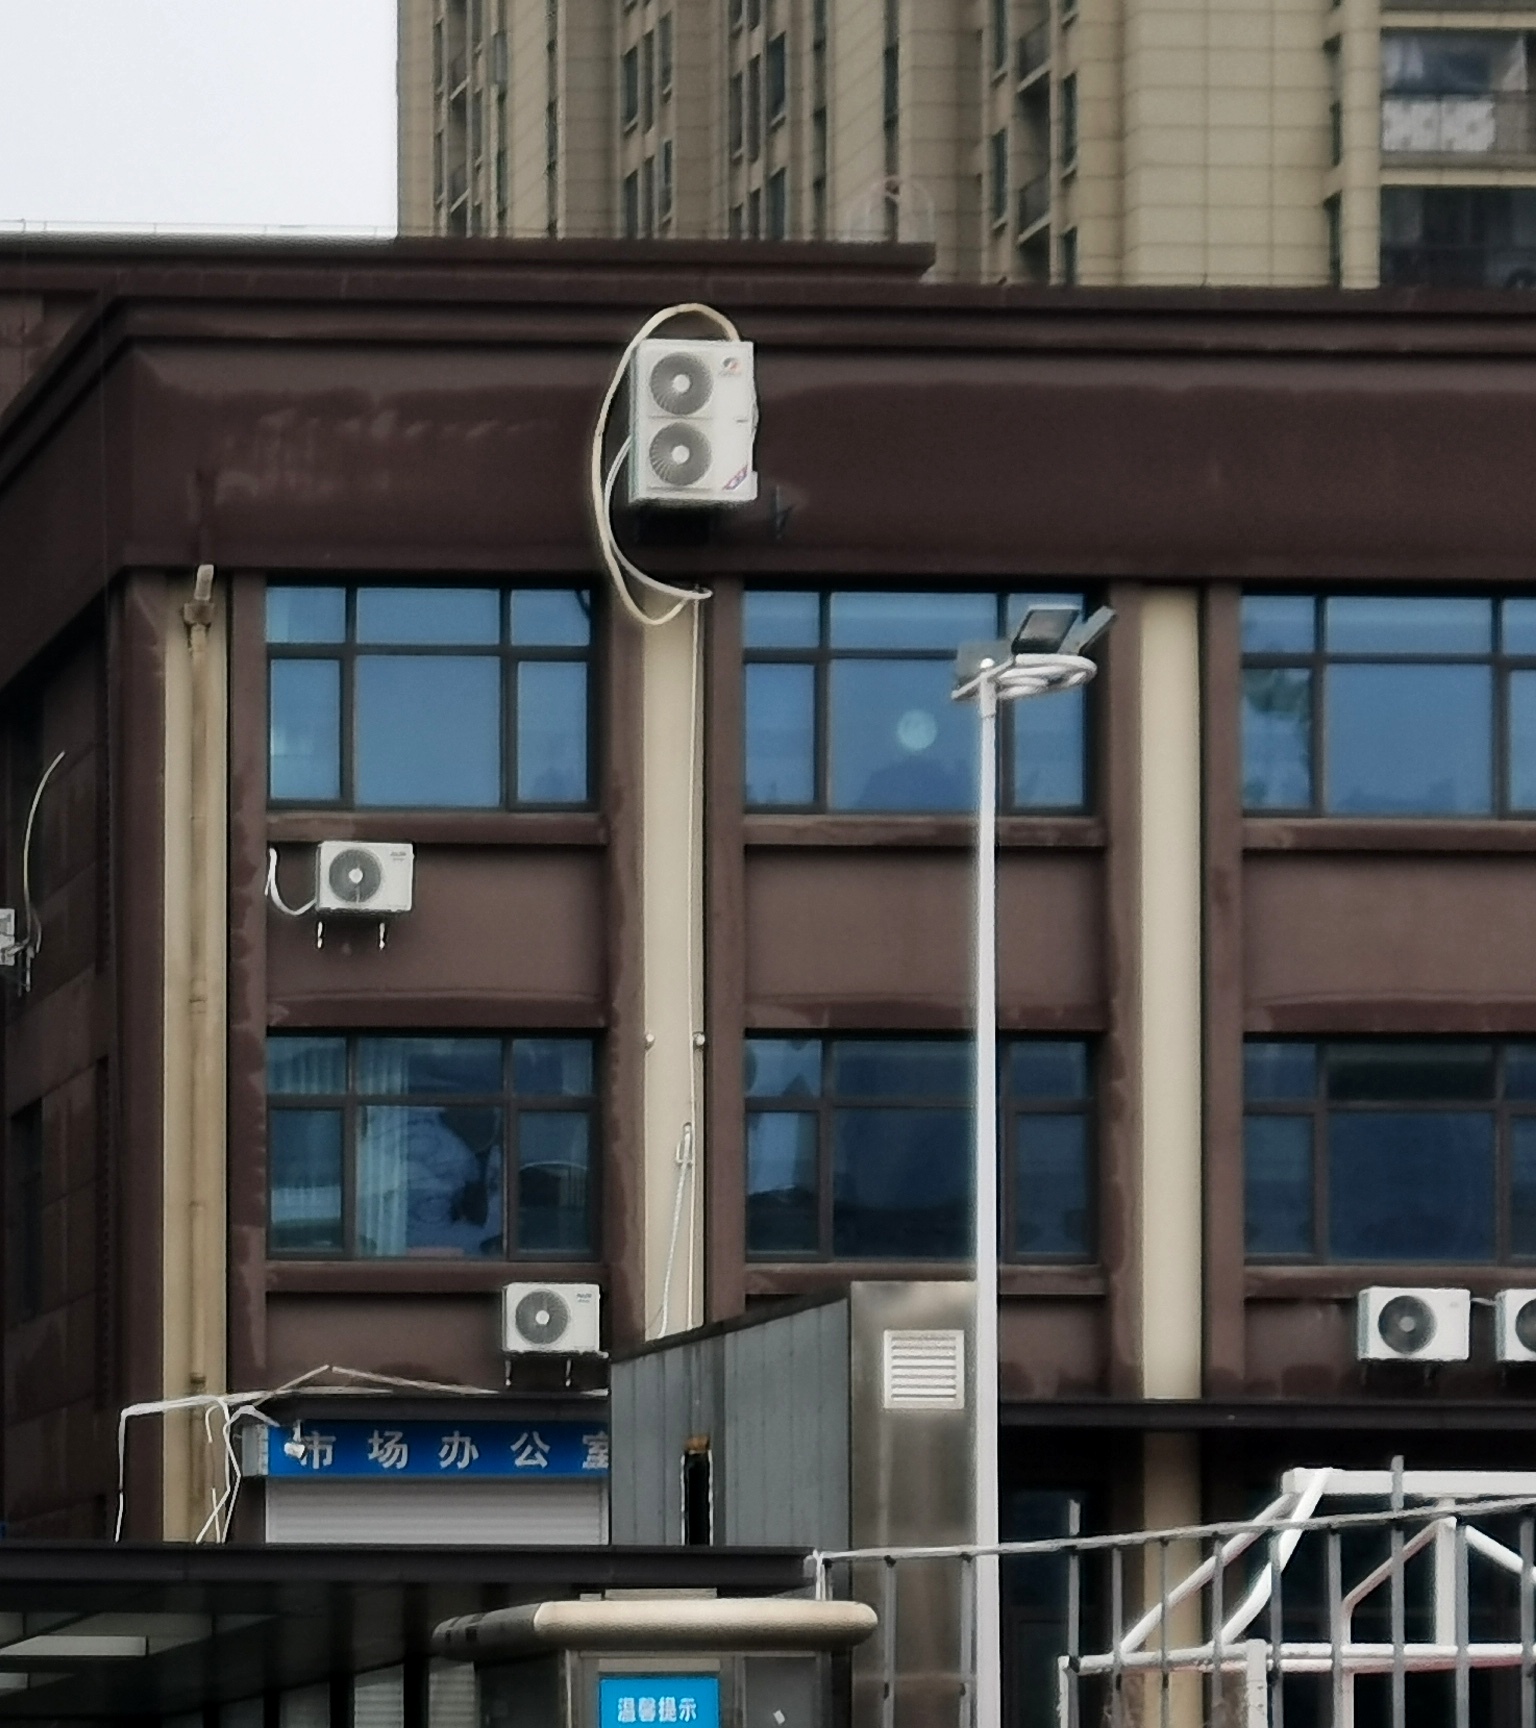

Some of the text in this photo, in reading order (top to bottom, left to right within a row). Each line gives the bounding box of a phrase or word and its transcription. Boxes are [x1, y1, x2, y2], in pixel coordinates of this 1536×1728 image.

[299, 1429, 610, 1471] 市场办公室
[617, 1696, 697, 1723] 温馨提示
